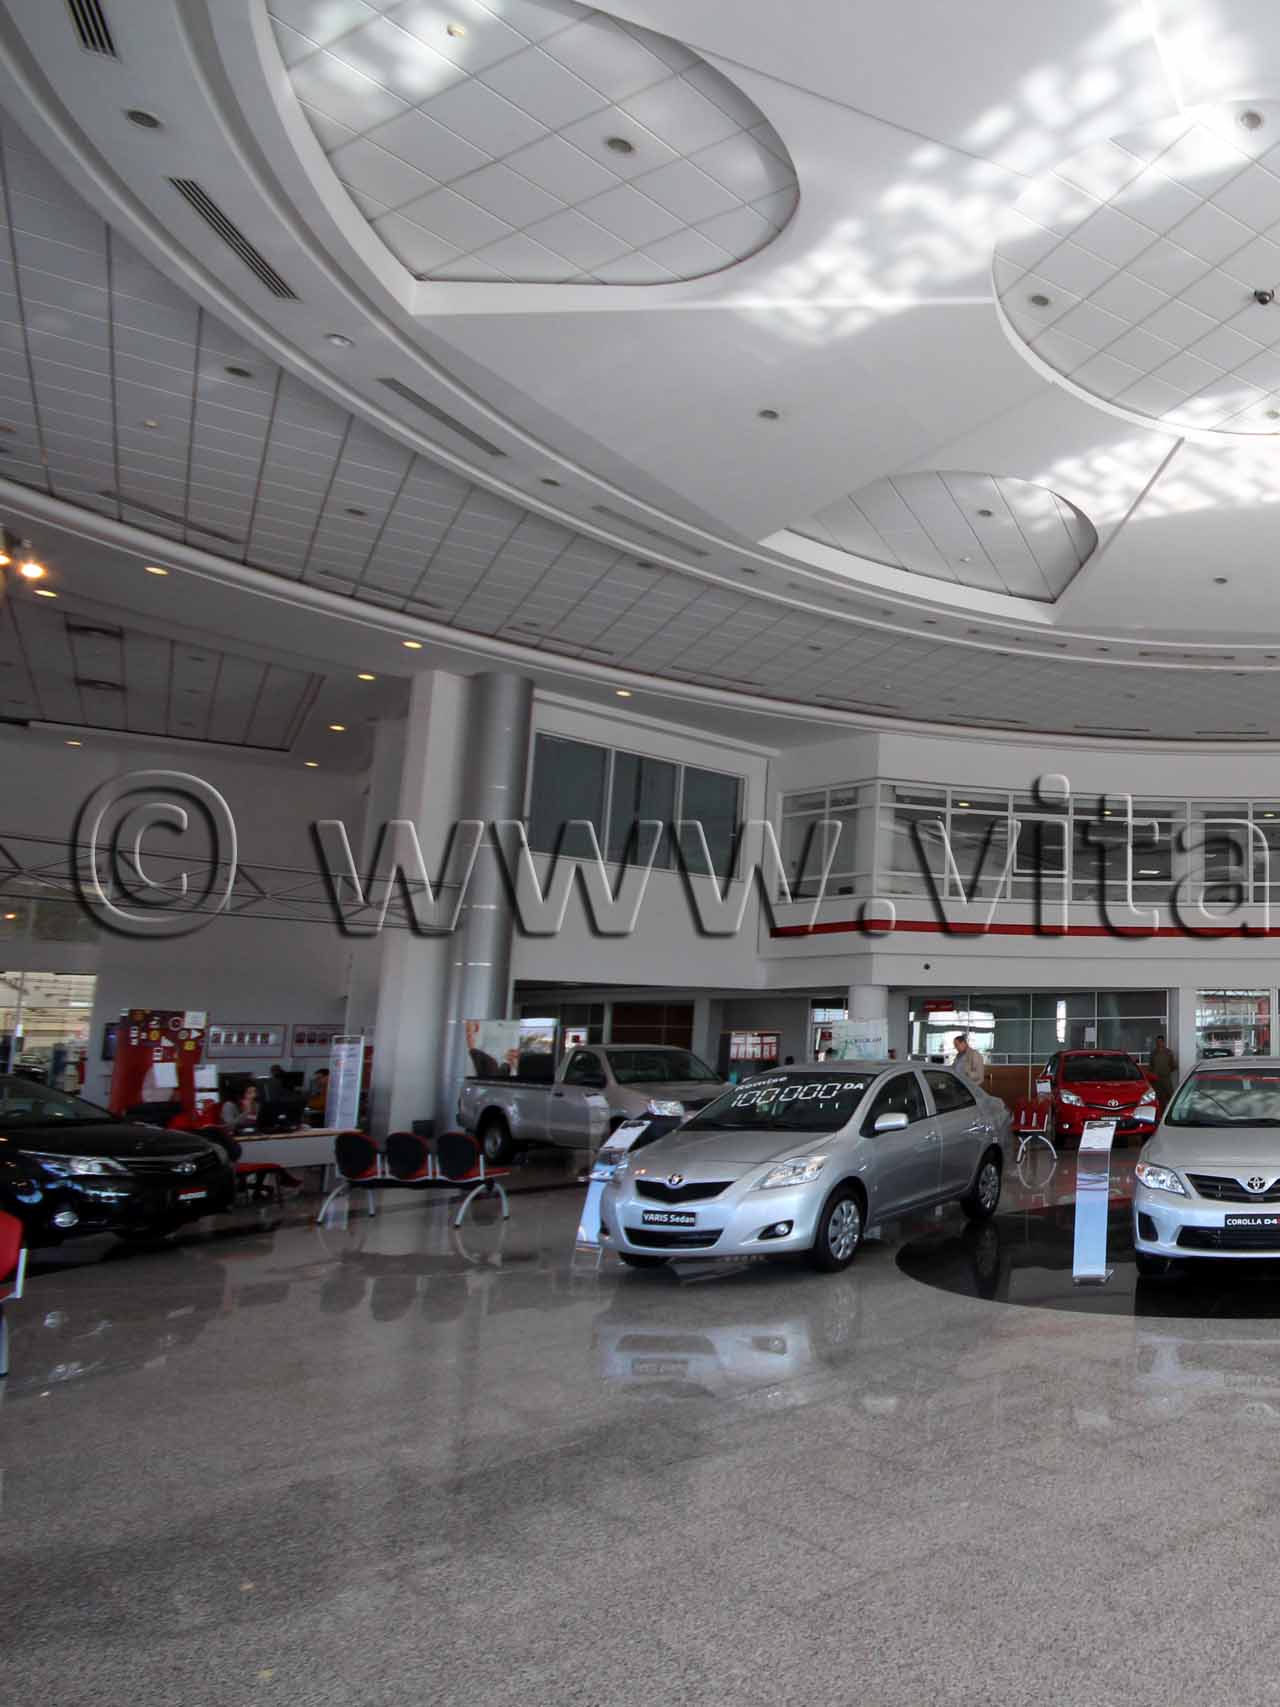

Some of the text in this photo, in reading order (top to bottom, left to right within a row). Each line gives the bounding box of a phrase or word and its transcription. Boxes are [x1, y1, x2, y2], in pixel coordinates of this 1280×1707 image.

[843, 1082, 866, 1090] DA
[643, 1213, 668, 1222] YARIS
[1226, 1218, 1262, 1226] COROLLA
